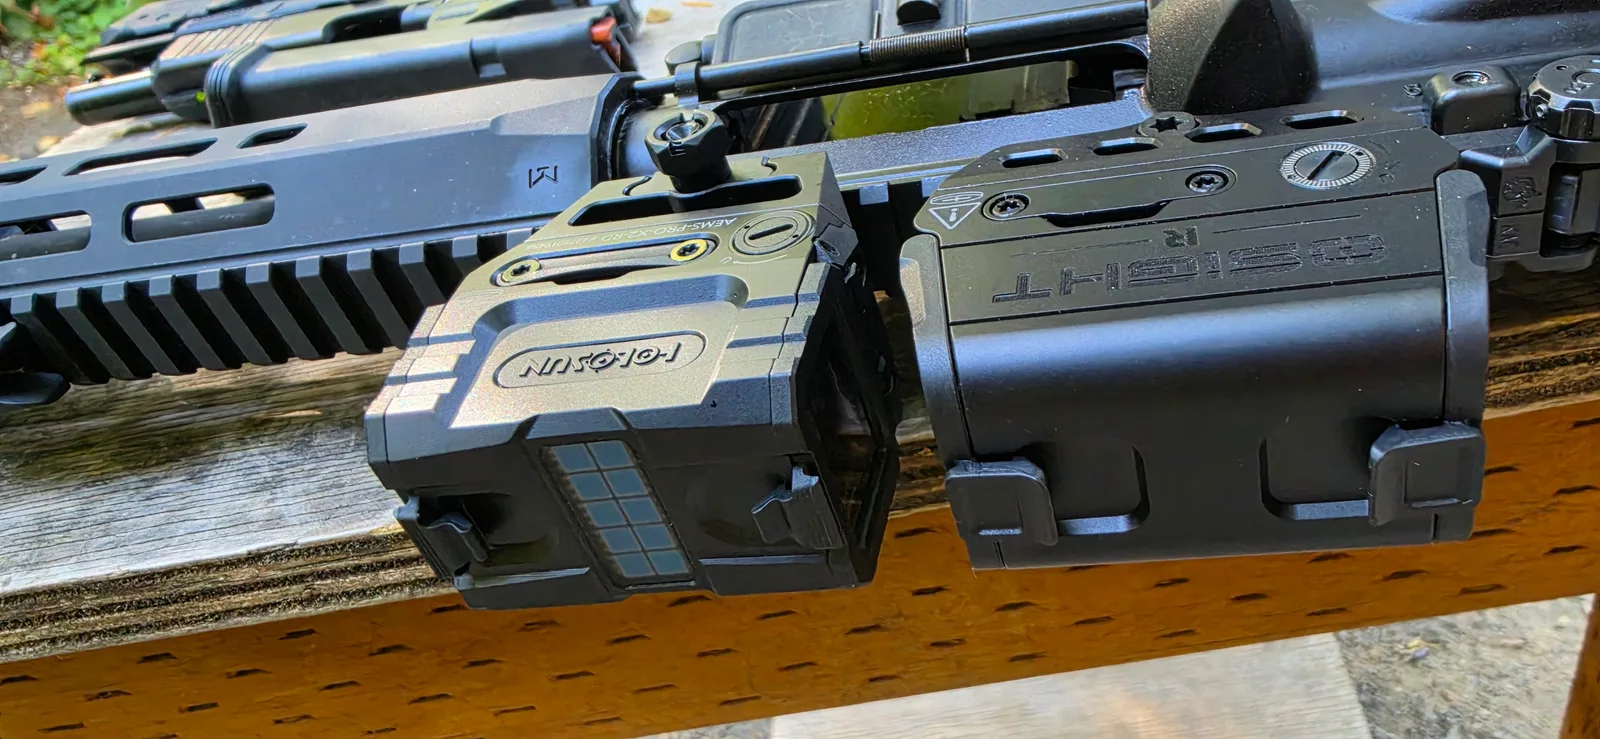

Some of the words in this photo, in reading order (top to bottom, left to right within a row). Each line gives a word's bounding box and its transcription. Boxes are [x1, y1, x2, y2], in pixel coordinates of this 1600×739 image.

[602, 217, 738, 242] AEMS-PRO-X2-RD
[991, 233, 1389, 304] OSIGHT
[518, 341, 683, 378] HOLOSUN
